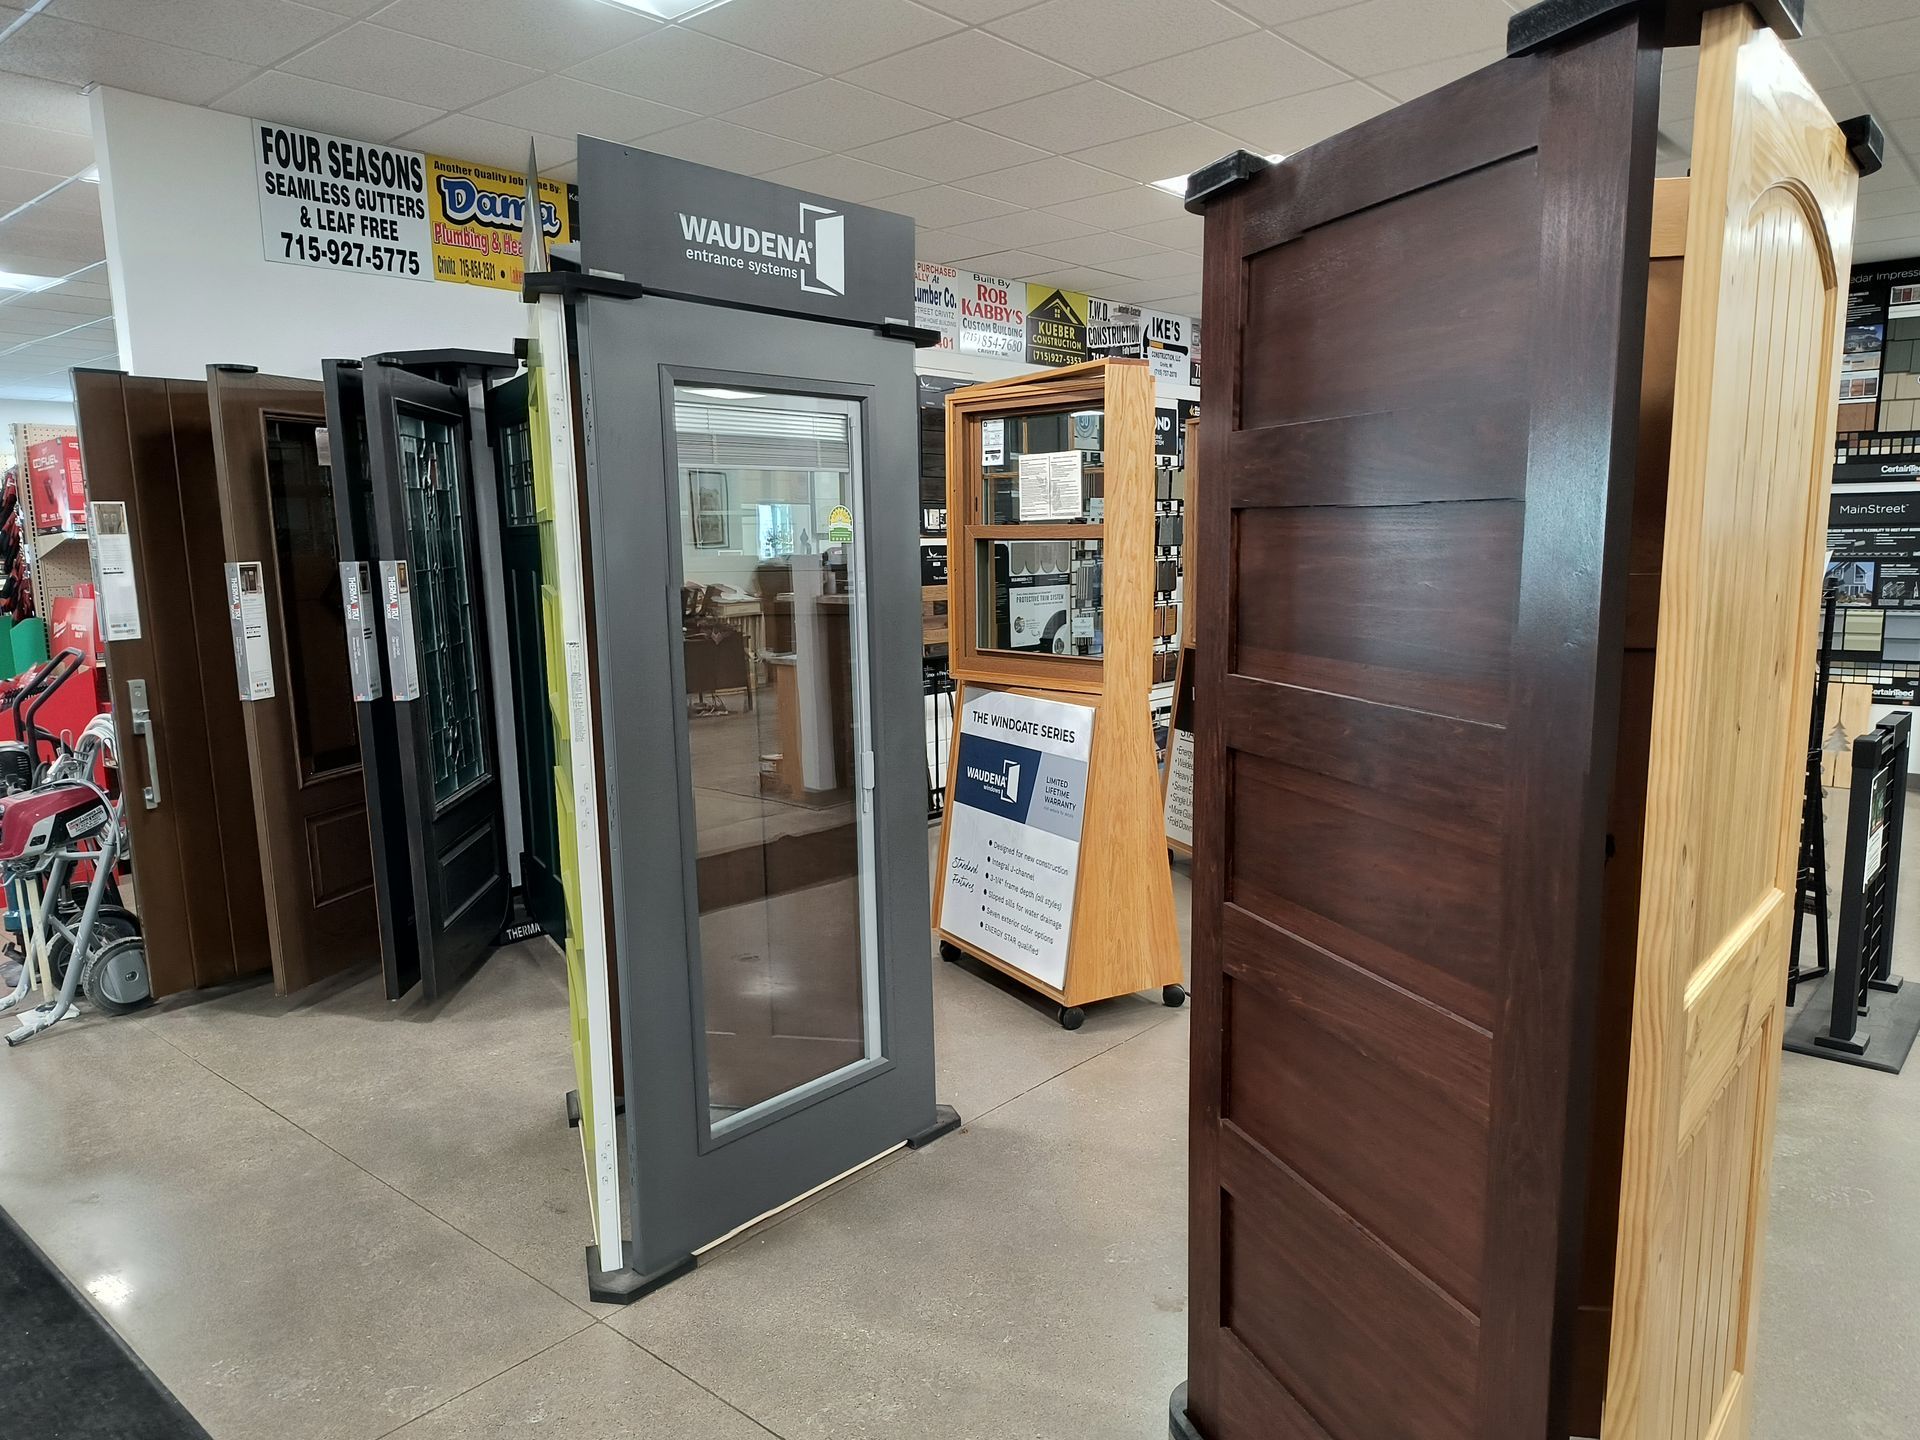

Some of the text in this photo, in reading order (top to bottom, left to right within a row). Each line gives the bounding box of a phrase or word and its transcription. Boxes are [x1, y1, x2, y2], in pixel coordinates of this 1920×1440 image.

[261, 126, 424, 194] FOUR SEASONS
[434, 161, 472, 176] Another
[474, 168, 507, 184] Quality
[509, 175, 524, 186] Job
[264, 171, 425, 220] SEAMLESS GUTTERS
[300, 206, 399, 242] & LEAF FREE
[434, 223, 489, 256] Plumbing
[491, 231, 501, 254] &
[280, 231, 420, 276] 715-927-5775
[437, 255, 456, 275] Crivitz
[686, 248, 798, 279] entrance systems
[917, 262, 957, 278] PURCHASED
[931, 275, 940, 284] At
[973, 273, 1011, 289] Built By
[944, 287, 957, 309] Co.
[977, 284, 1008, 305] ROB
[961, 298, 1023, 325] KABBY'S
[1088, 300, 1110, 322] T.W.D.
[962, 318, 992, 332] CUSTOM
[992, 323, 1023, 338] BUILDING
[1038, 321, 1076, 340] KUEBER
[1087, 324, 1140, 346] CONSTRUCTION
[1152, 316, 1180, 341] IKE'S
[982, 335, 1023, 352] 854-7680
[1032, 334, 1082, 350] CONSTRUCTION
[348, 577, 358, 605] THERMA
[387, 576, 398, 605] THERMA
[973, 710, 1075, 744] THE WINDGATE SERIES
[1045, 785, 1070, 799] LIFETIME
[1046, 776, 1068, 788] LIMITED
[1044, 795, 1077, 811] WARRANTY
[992, 857, 1034, 882] Integral J-channel
[993, 841, 1069, 876] Designed for new construction
[1004, 880, 1019, 893] frame
[1020, 887, 1034, 899] depth
[1044, 898, 1062, 912] styles)
[988, 890, 1004, 903] Sloped
[1005, 898, 1015, 909] sills
[1024, 907, 1039, 918] water
[1040, 913, 1062, 930] drainage
[506, 922, 541, 940] THERMA
[986, 907, 1054, 944] Seven exterior color options
[984, 923, 1039, 956] ENERGY STAR qualified
